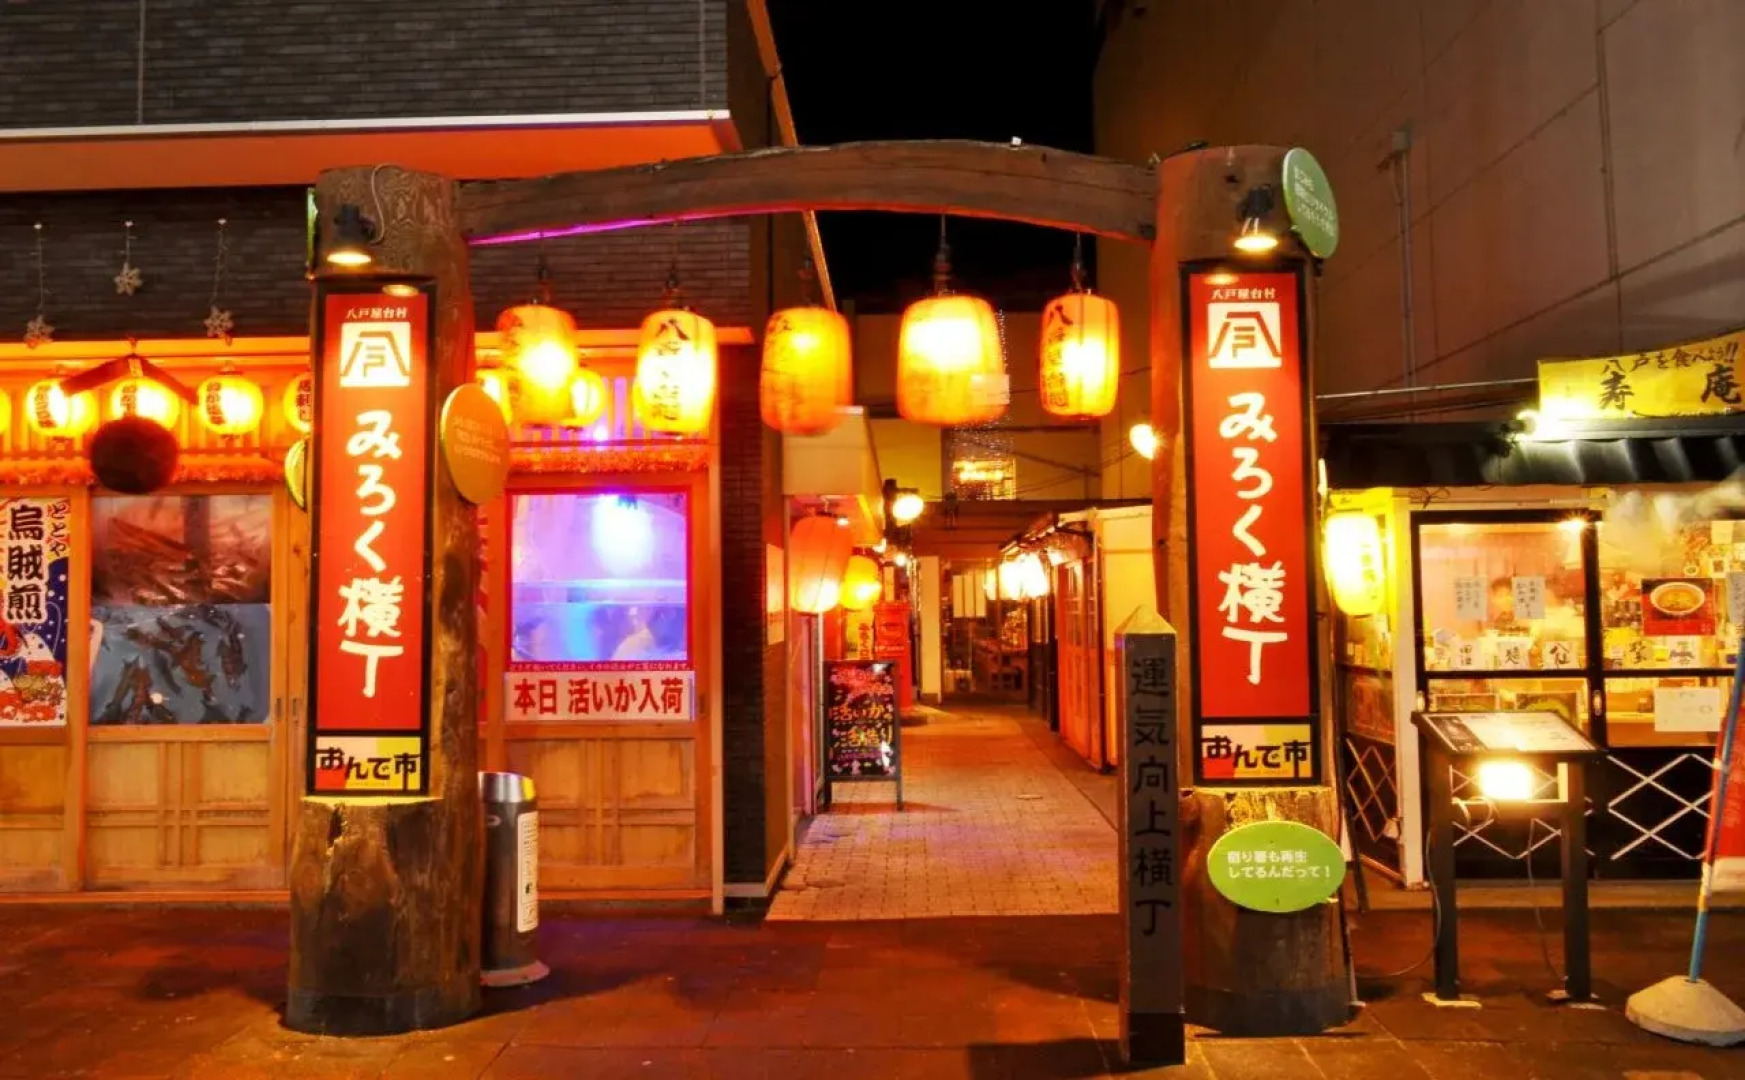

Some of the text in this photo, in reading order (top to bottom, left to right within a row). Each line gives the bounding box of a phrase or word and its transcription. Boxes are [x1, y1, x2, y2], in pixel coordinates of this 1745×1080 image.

[346, 307, 408, 319] 八戸屋台村
[1211, 288, 1276, 300] 八戸屋台村
[50, 502, 68, 557] ととや
[338, 410, 404, 698] みろく横丁
[1218, 392, 1287, 685] みろく横丁
[514, 678, 684, 716] 本日 活いか入荷
[1131, 657, 1174, 937] 運気向上横丁
